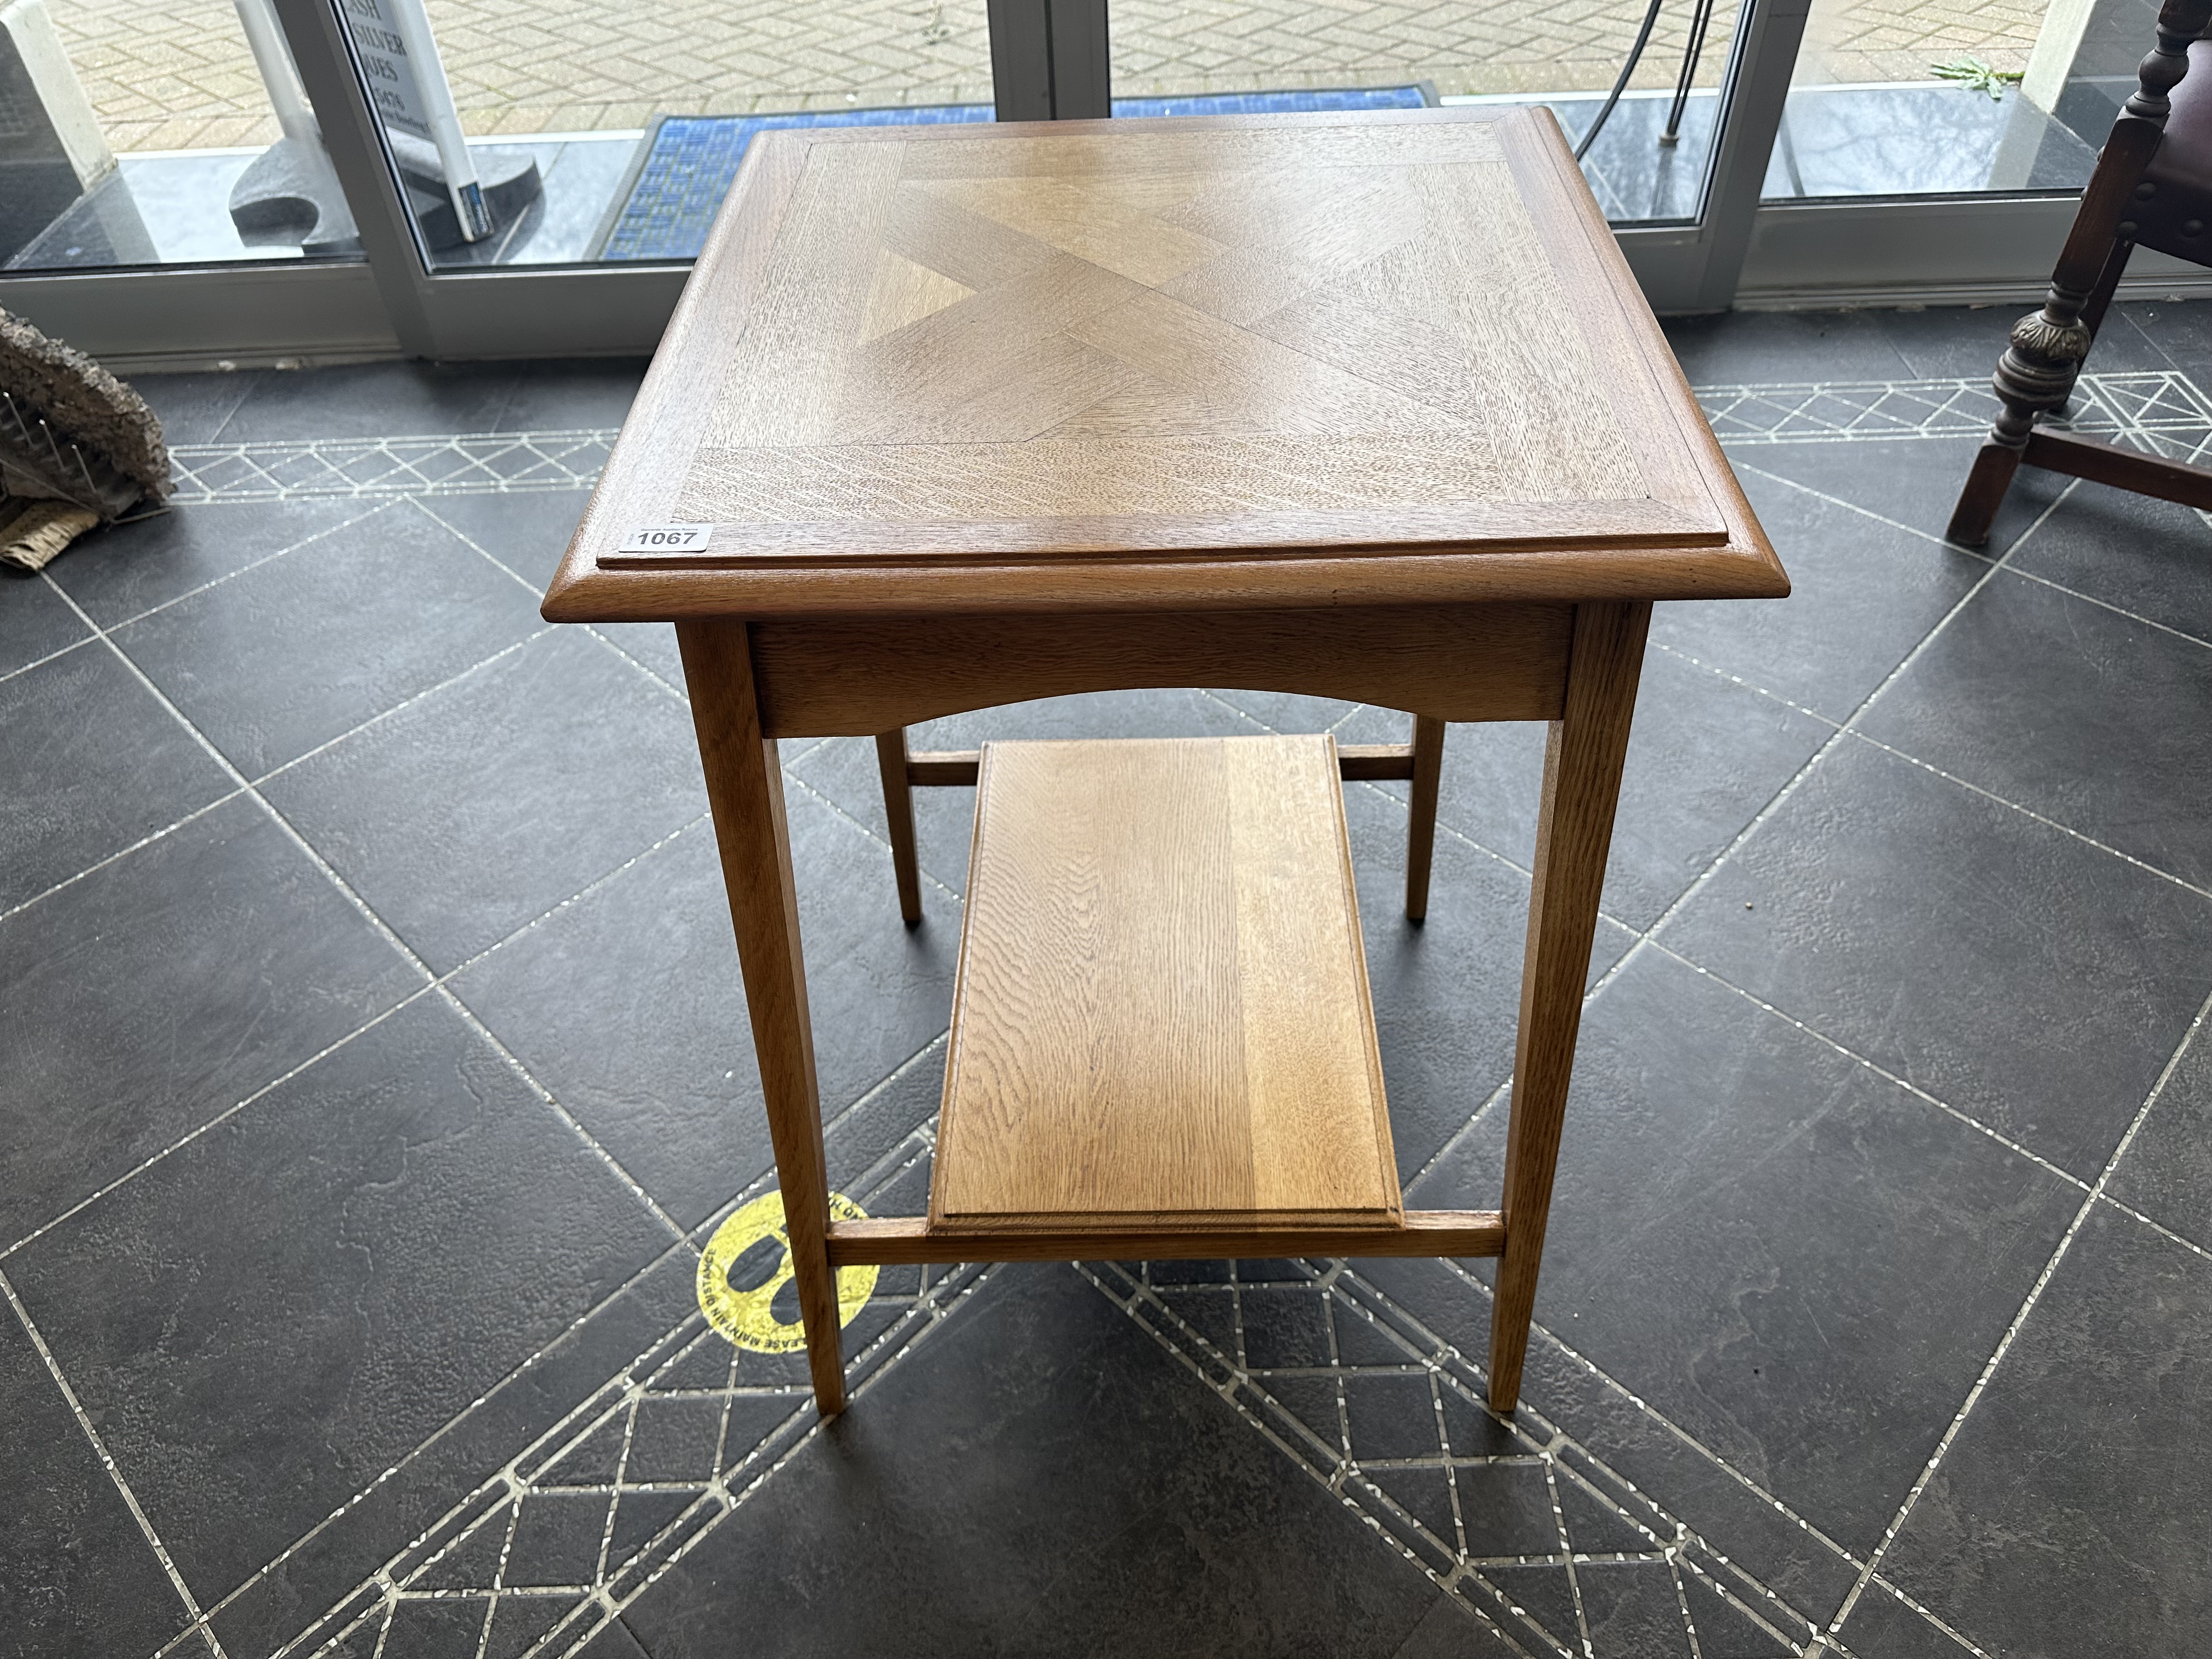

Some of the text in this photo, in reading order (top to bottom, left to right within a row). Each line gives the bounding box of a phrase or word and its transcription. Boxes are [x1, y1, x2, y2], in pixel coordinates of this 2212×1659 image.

[352, 22, 408, 56] SILVER
[638, 532, 698, 545] 1067
[702, 1248, 807, 1349] LEASE MAINTAIN DISTANCE
